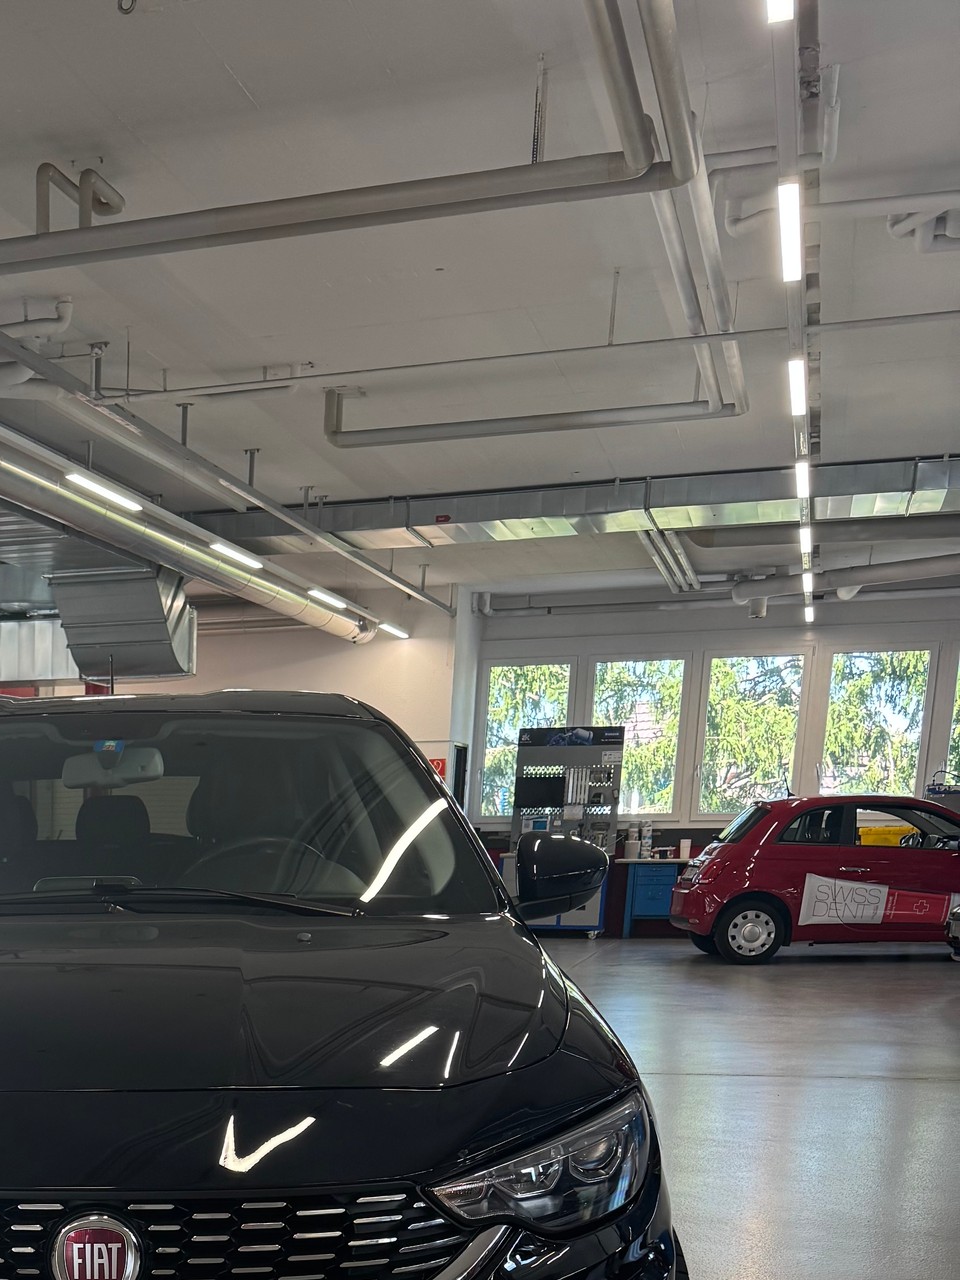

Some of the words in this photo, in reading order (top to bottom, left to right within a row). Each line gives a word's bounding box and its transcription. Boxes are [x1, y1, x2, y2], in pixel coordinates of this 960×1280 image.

[815, 884, 882, 905] SWISS
[812, 900, 873, 920] DENT
[72, 1242, 122, 1280] FIAT
